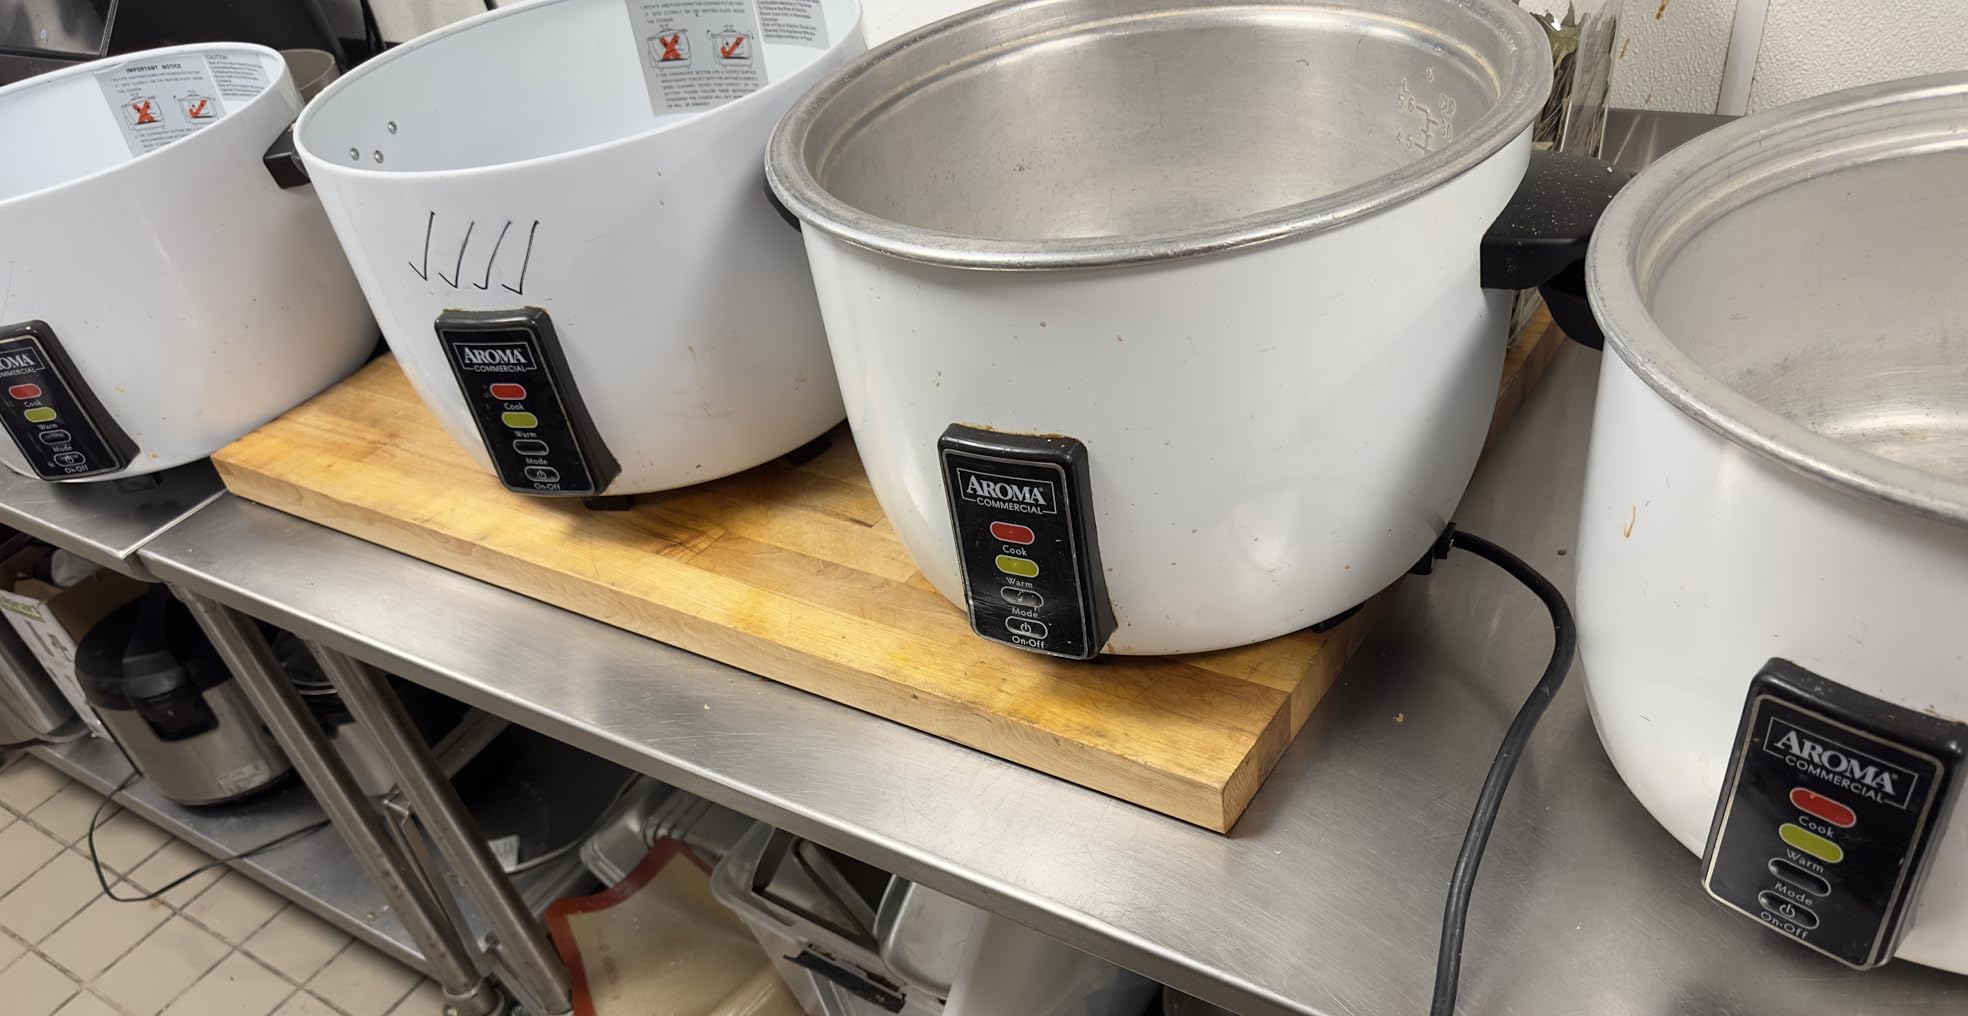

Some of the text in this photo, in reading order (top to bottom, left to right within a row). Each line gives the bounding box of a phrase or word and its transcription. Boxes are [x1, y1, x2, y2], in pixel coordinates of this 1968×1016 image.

[126, 63, 158, 73] IMPORTANT
[0, 354, 35, 370] OMA
[464, 347, 527, 364] AROMA
[0, 367, 37, 378] MMERCIAL
[473, 364, 528, 373] COMMERCIAL
[24, 400, 42, 408] Cook
[504, 402, 525, 410] Cook
[534, 482, 561, 491] On-Off
[966, 475, 1047, 505] AROMA
[976, 497, 1043, 514] COMMERCIAL
[1002, 545, 1028, 556] Cook
[1006, 577, 1033, 588] Warm
[1012, 607, 1038, 618] Mode
[1012, 635, 1045, 648] On-Off
[1774, 729, 1896, 795] AROMA
[1785, 757, 1884, 803] COMMERCIAL
[1798, 815, 1834, 838] Cook
[1786, 848, 1824, 873] Warm
[1775, 882, 1813, 906] Mode
[1761, 911, 1808, 939] On-Off
